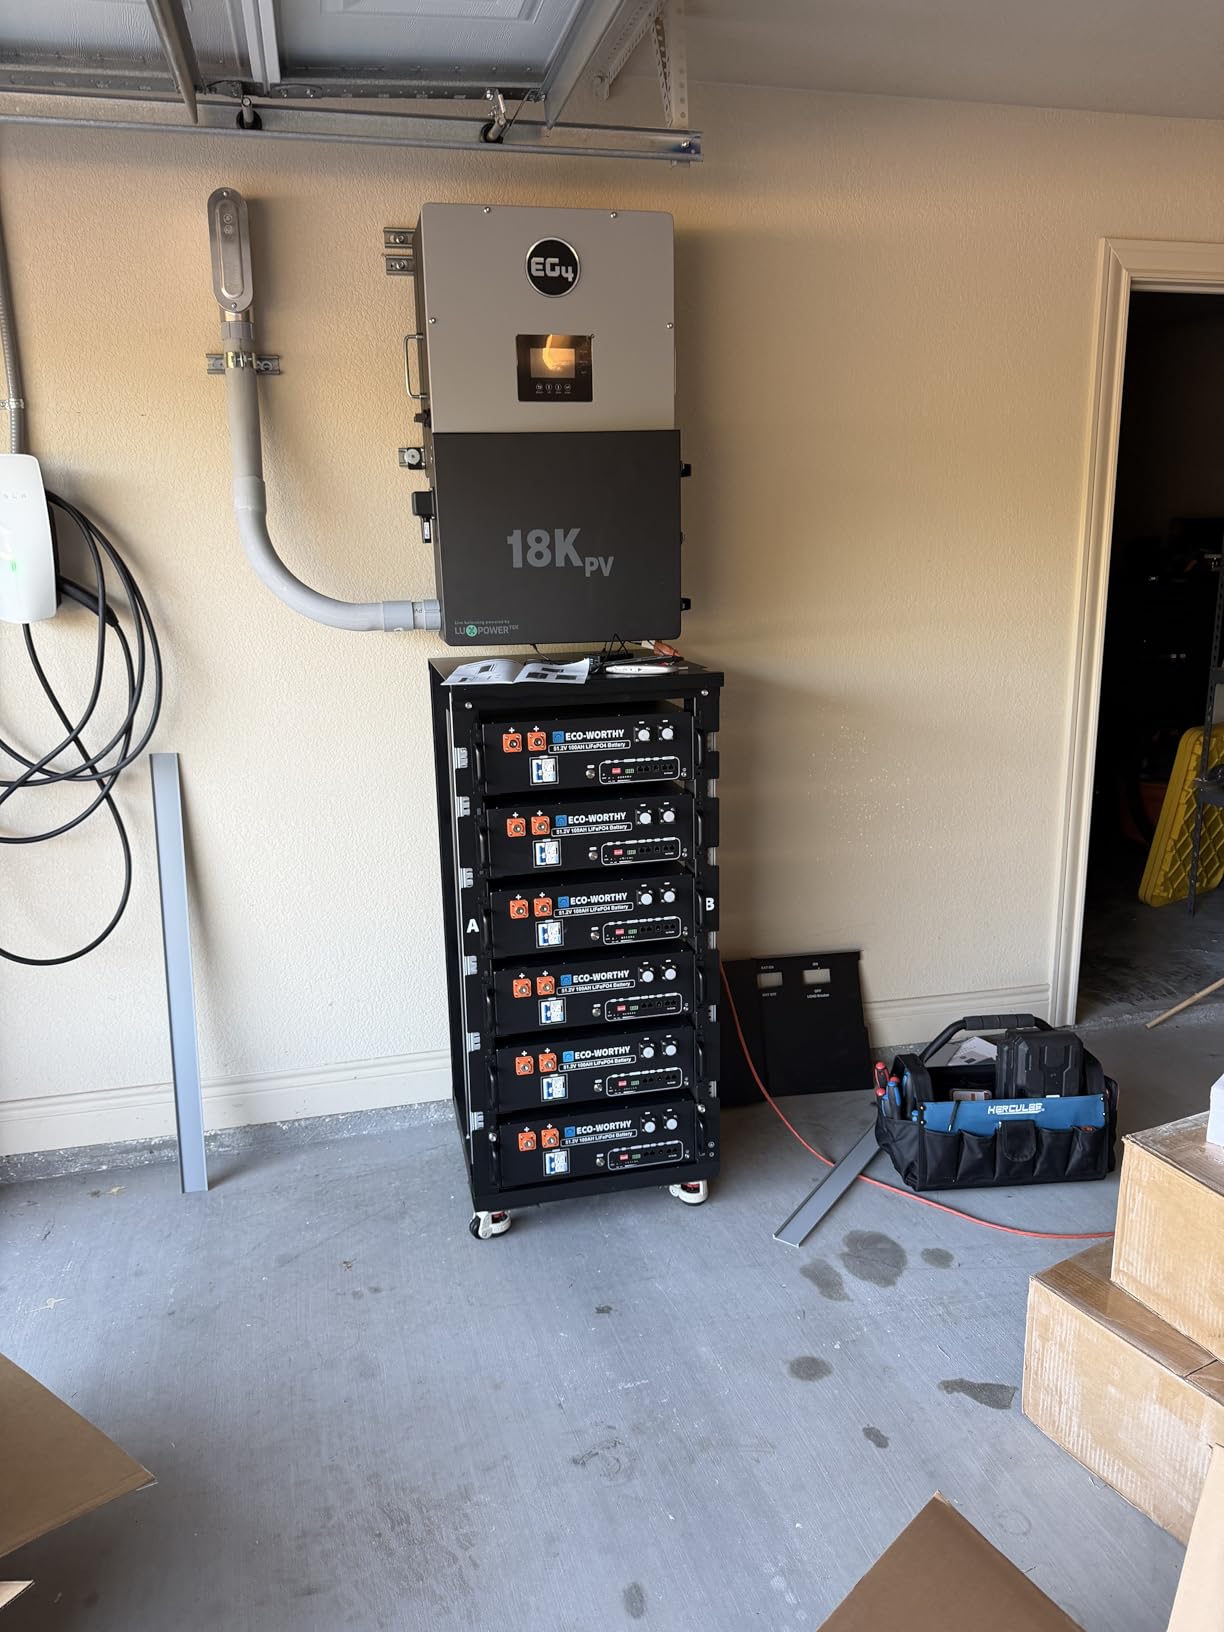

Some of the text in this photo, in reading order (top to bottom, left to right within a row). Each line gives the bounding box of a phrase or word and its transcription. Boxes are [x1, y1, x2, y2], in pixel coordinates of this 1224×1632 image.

[530, 256, 574, 282] EG4
[565, 729, 625, 741] ECO-WORTHY
[568, 811, 627, 824] ECO-WORTHY
[570, 892, 628, 905] ECO-WORTHY
[706, 897, 715, 911] B
[466, 918, 480, 933] A
[572, 970, 630, 983] ECO-WORTHY
[574, 1046, 630, 1060] ECO-WORTHY
[988, 1103, 1042, 1115] HERCULES
[576, 1120, 632, 1135] ECO-WORTHY
